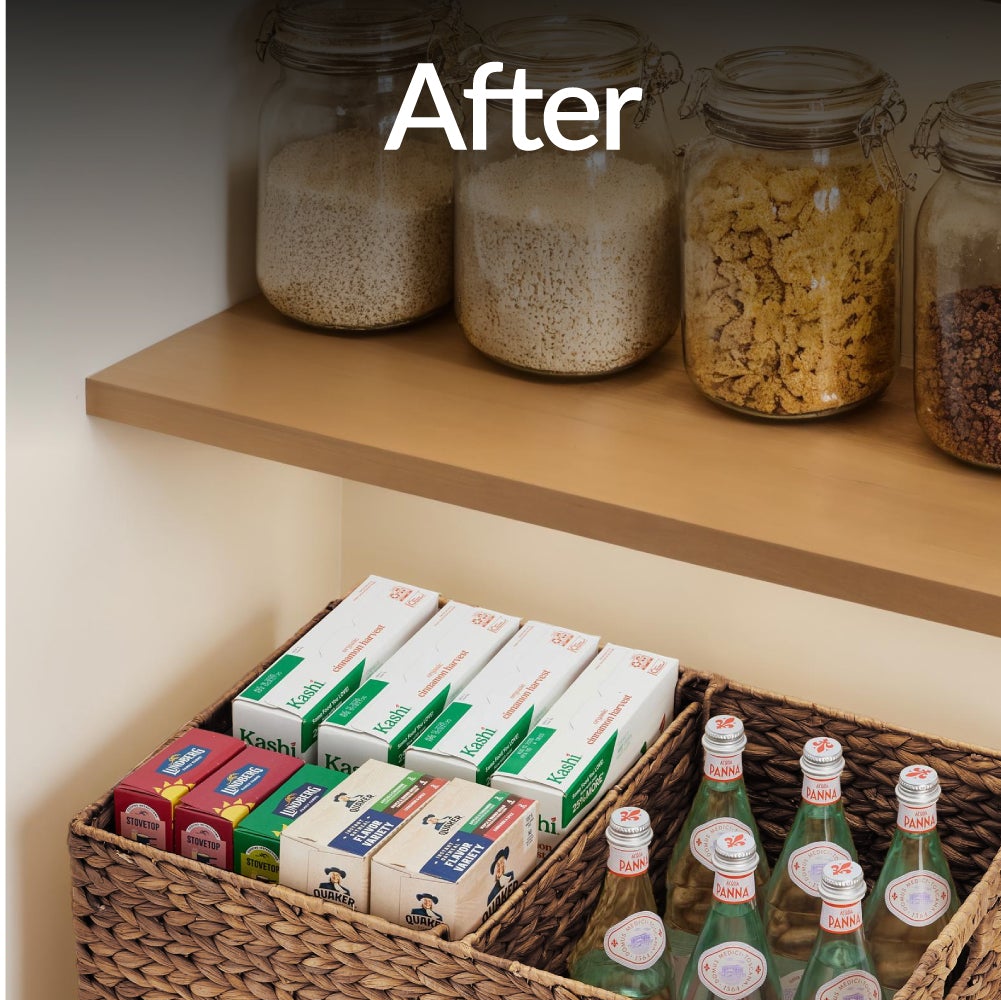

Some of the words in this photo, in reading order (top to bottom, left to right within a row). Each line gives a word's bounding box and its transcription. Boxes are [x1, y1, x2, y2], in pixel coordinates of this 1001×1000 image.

[332, 645, 362, 674] cinnamon
[361, 624, 385, 648] harvest
[417, 669, 446, 698] cinnamon
[445, 650, 469, 673] harvest
[286, 679, 327, 711] Kashi
[372, 703, 412, 735] Kashi
[587, 716, 615, 746] cinnamon
[612, 694, 633, 719] harvest
[459, 726, 498, 758] Kashi
[162, 747, 206, 776] LUNDBERG
[546, 752, 583, 785] Kashi
[709, 764, 741, 777] PANNA
[221, 766, 264, 796] LUNDBERG
[807, 786, 838, 801] PANNA
[279, 785, 322, 818] LUNDBERG
[126, 816, 160, 832] STOVETOP
[353, 820, 383, 843] FLAVOR
[362, 822, 395, 847] VARIETY
[904, 815, 936, 829] PANNA
[186, 835, 221, 851] STOVETOP
[444, 842, 473, 867] FLAVOR
[246, 857, 281, 873] STOVETOP
[453, 843, 485, 872] VARIETY
[313, 889, 356, 907] QUAKER
[716, 883, 750, 899] PANNA
